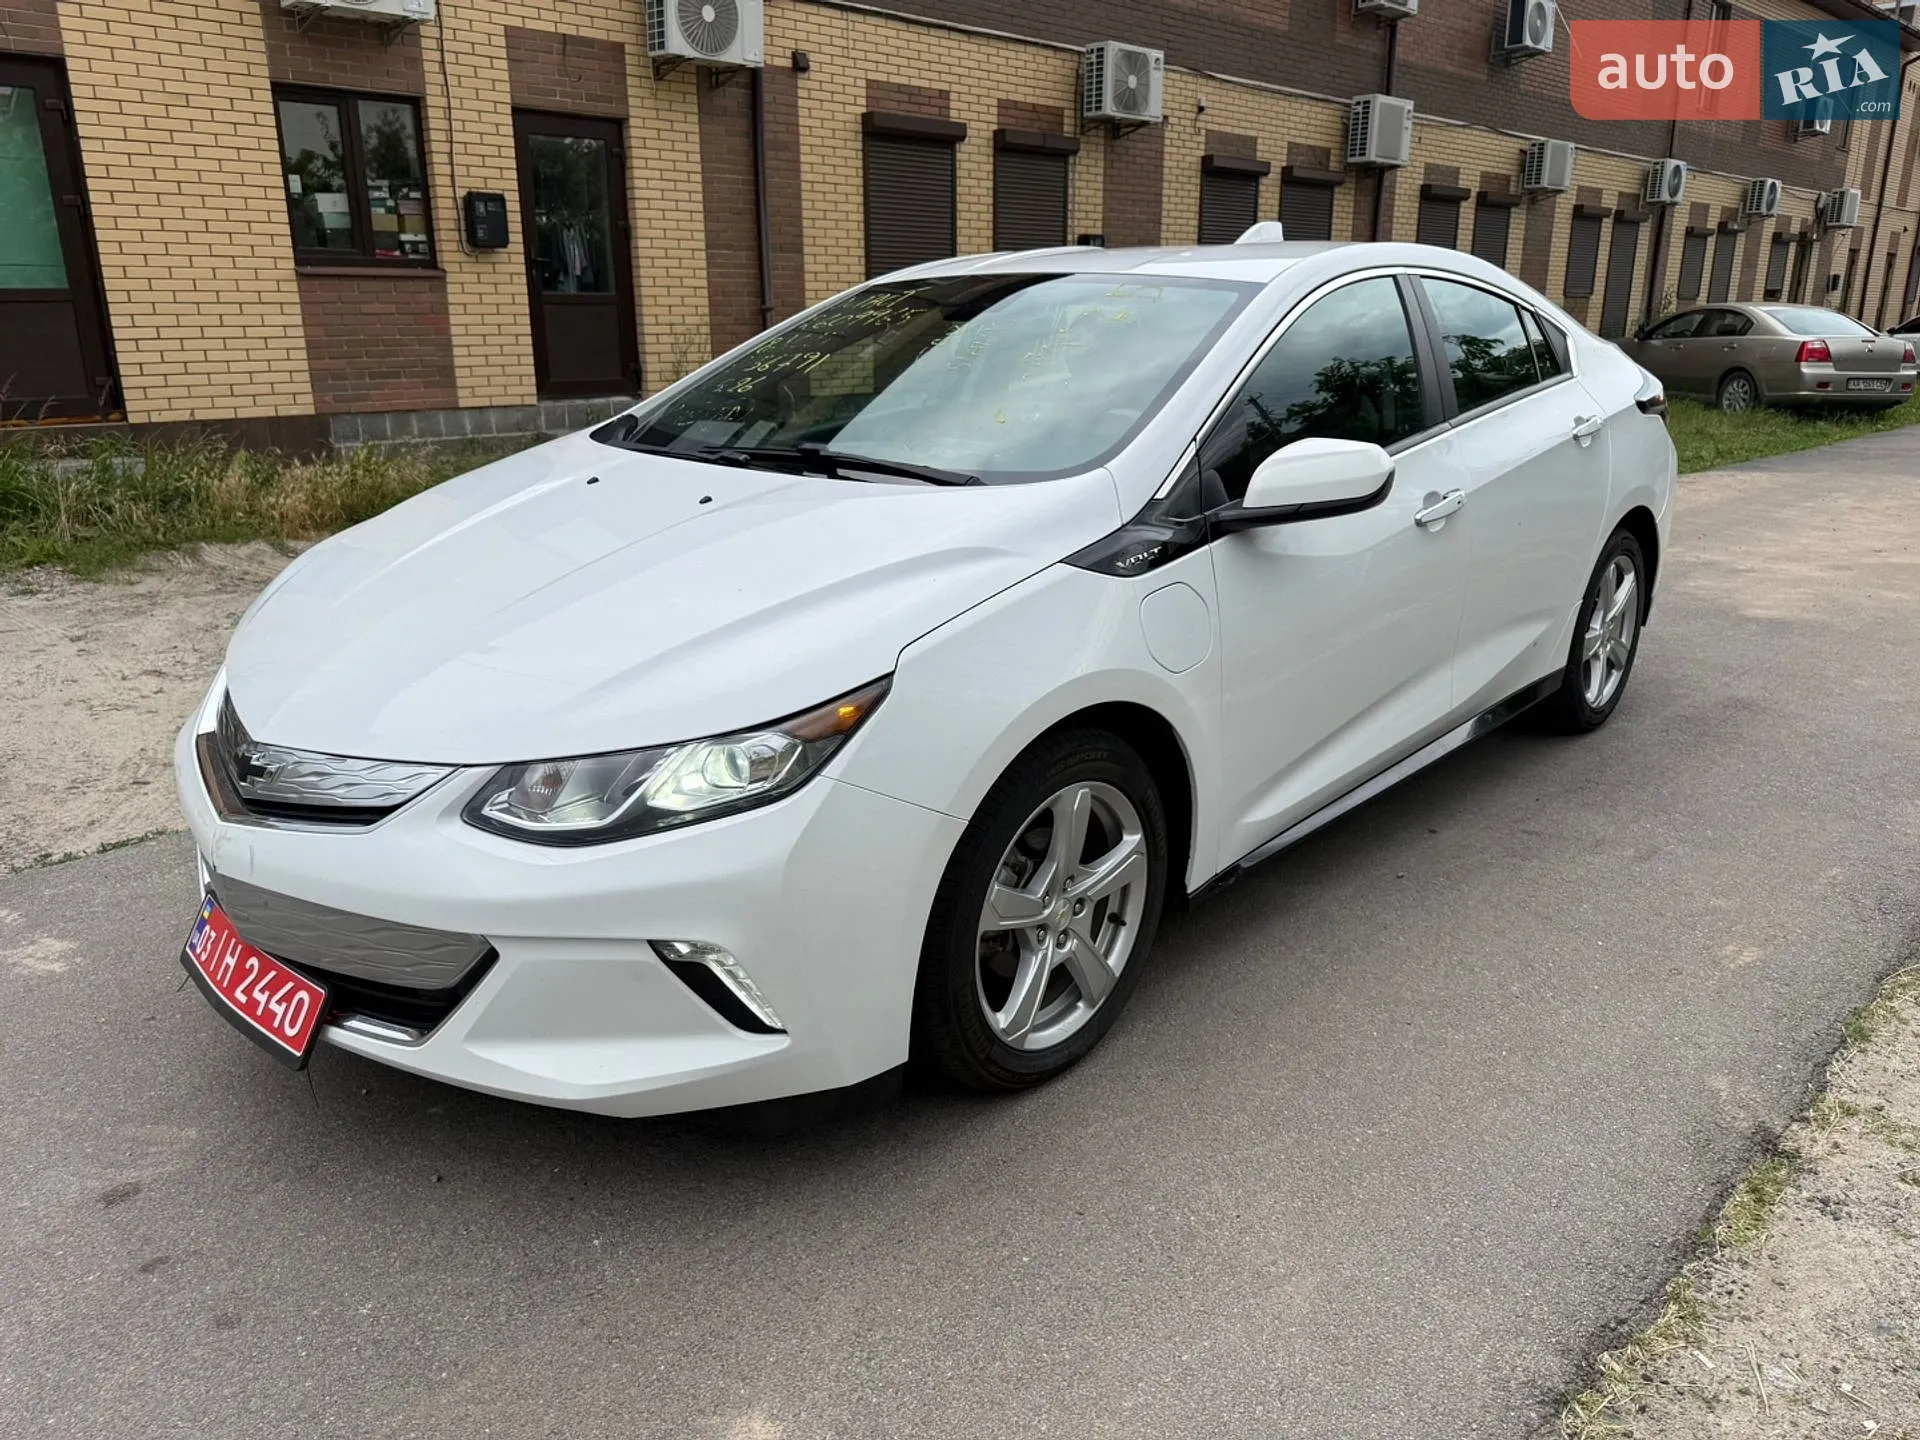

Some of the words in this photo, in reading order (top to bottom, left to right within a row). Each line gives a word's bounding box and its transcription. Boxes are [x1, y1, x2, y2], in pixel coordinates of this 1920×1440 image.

[1115, 546, 1162, 568] VOLT
[196, 924, 217, 962] 03
[234, 957, 310, 1037] 2440
